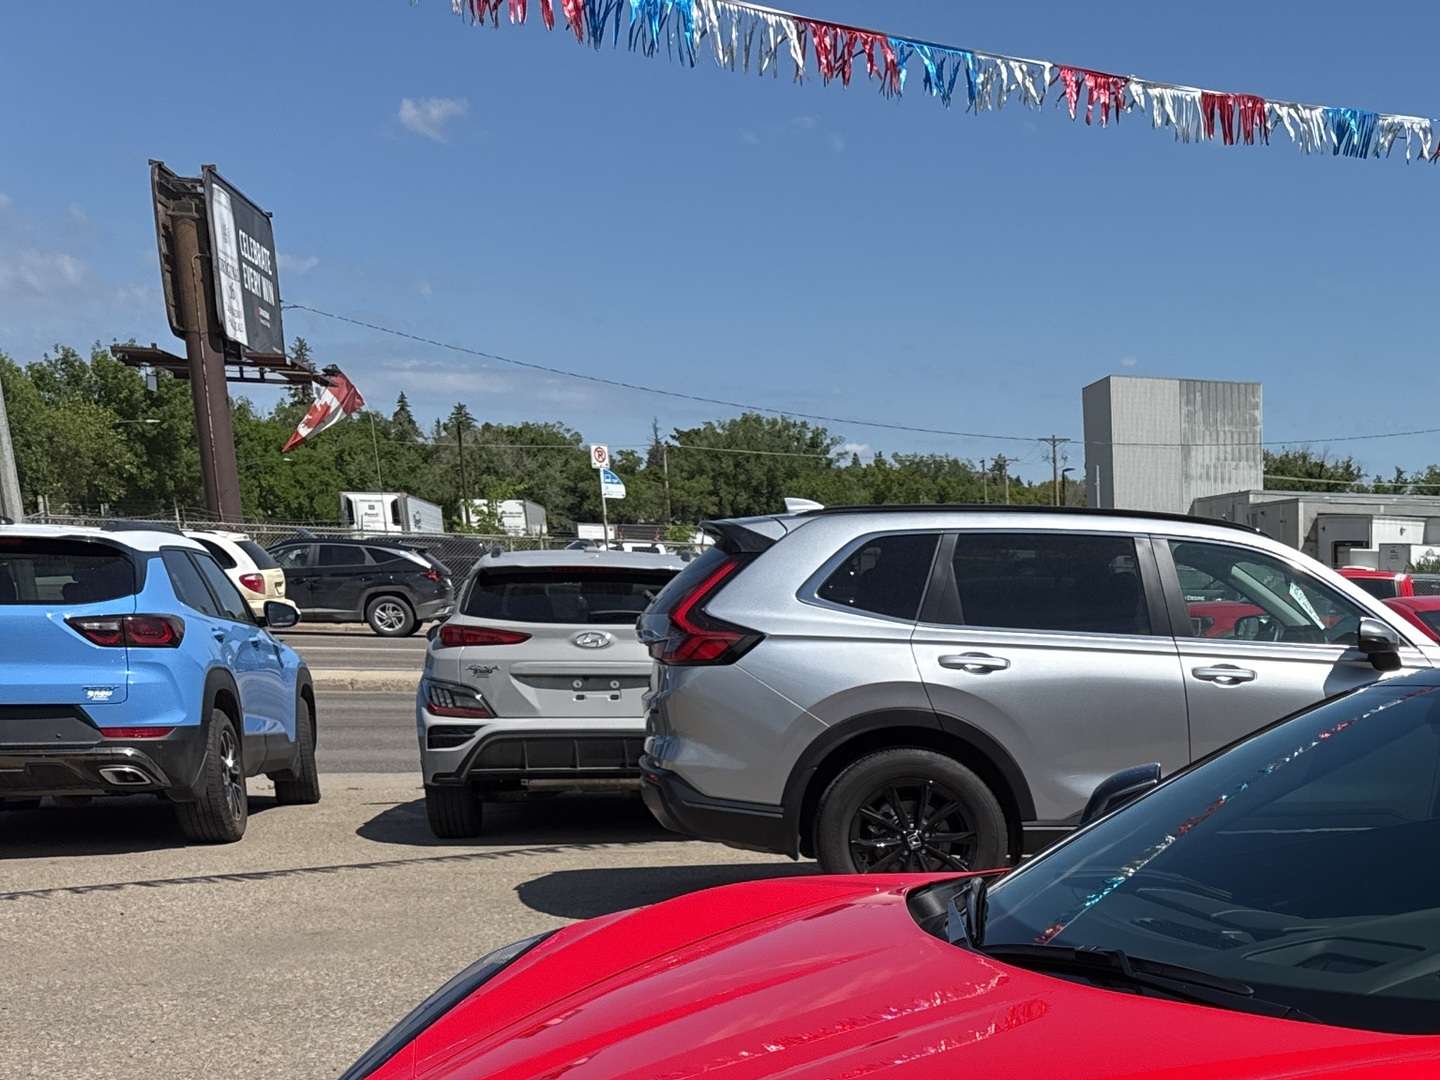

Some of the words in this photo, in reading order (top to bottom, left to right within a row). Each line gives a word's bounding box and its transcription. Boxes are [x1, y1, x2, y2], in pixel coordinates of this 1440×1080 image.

[239, 229, 273, 276] CELEBRATE
[242, 263, 262, 298] EVERY
[261, 276, 275, 306] WIN
